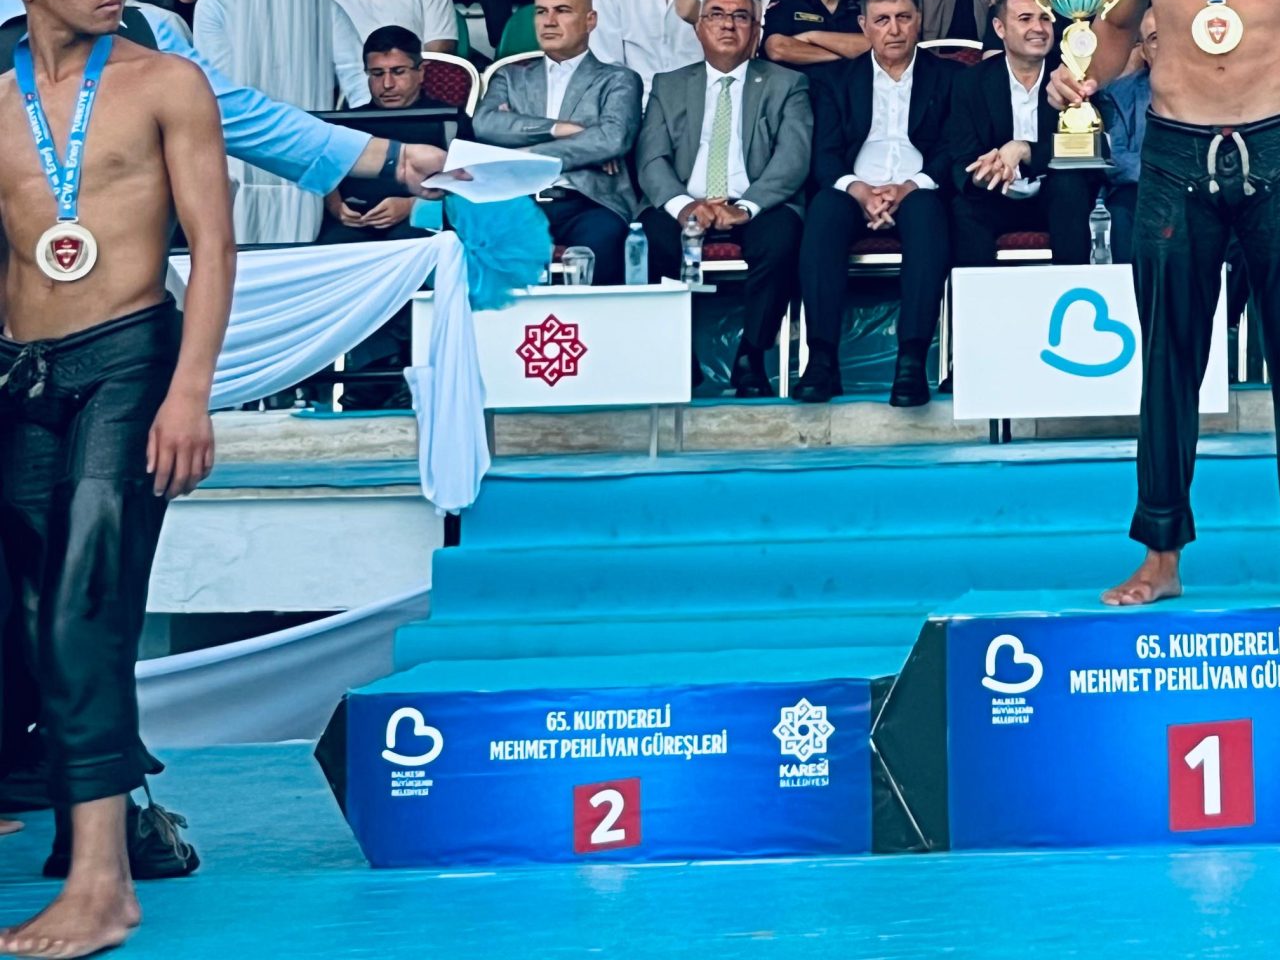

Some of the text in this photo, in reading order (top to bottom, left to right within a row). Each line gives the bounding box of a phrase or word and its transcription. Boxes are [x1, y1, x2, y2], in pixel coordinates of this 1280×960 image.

[1136, 634, 1166, 659] 65.
[1070, 667, 1152, 694] MEHMET
[1155, 661, 1248, 691] PEHLİVAN
[546, 703, 671, 731] 65. KURTDERELİ
[490, 729, 728, 760] MEHMET PEHLİVAN GÜREŞLERİ
[1183, 735, 1222, 816] 1
[589, 789, 626, 844] 2
